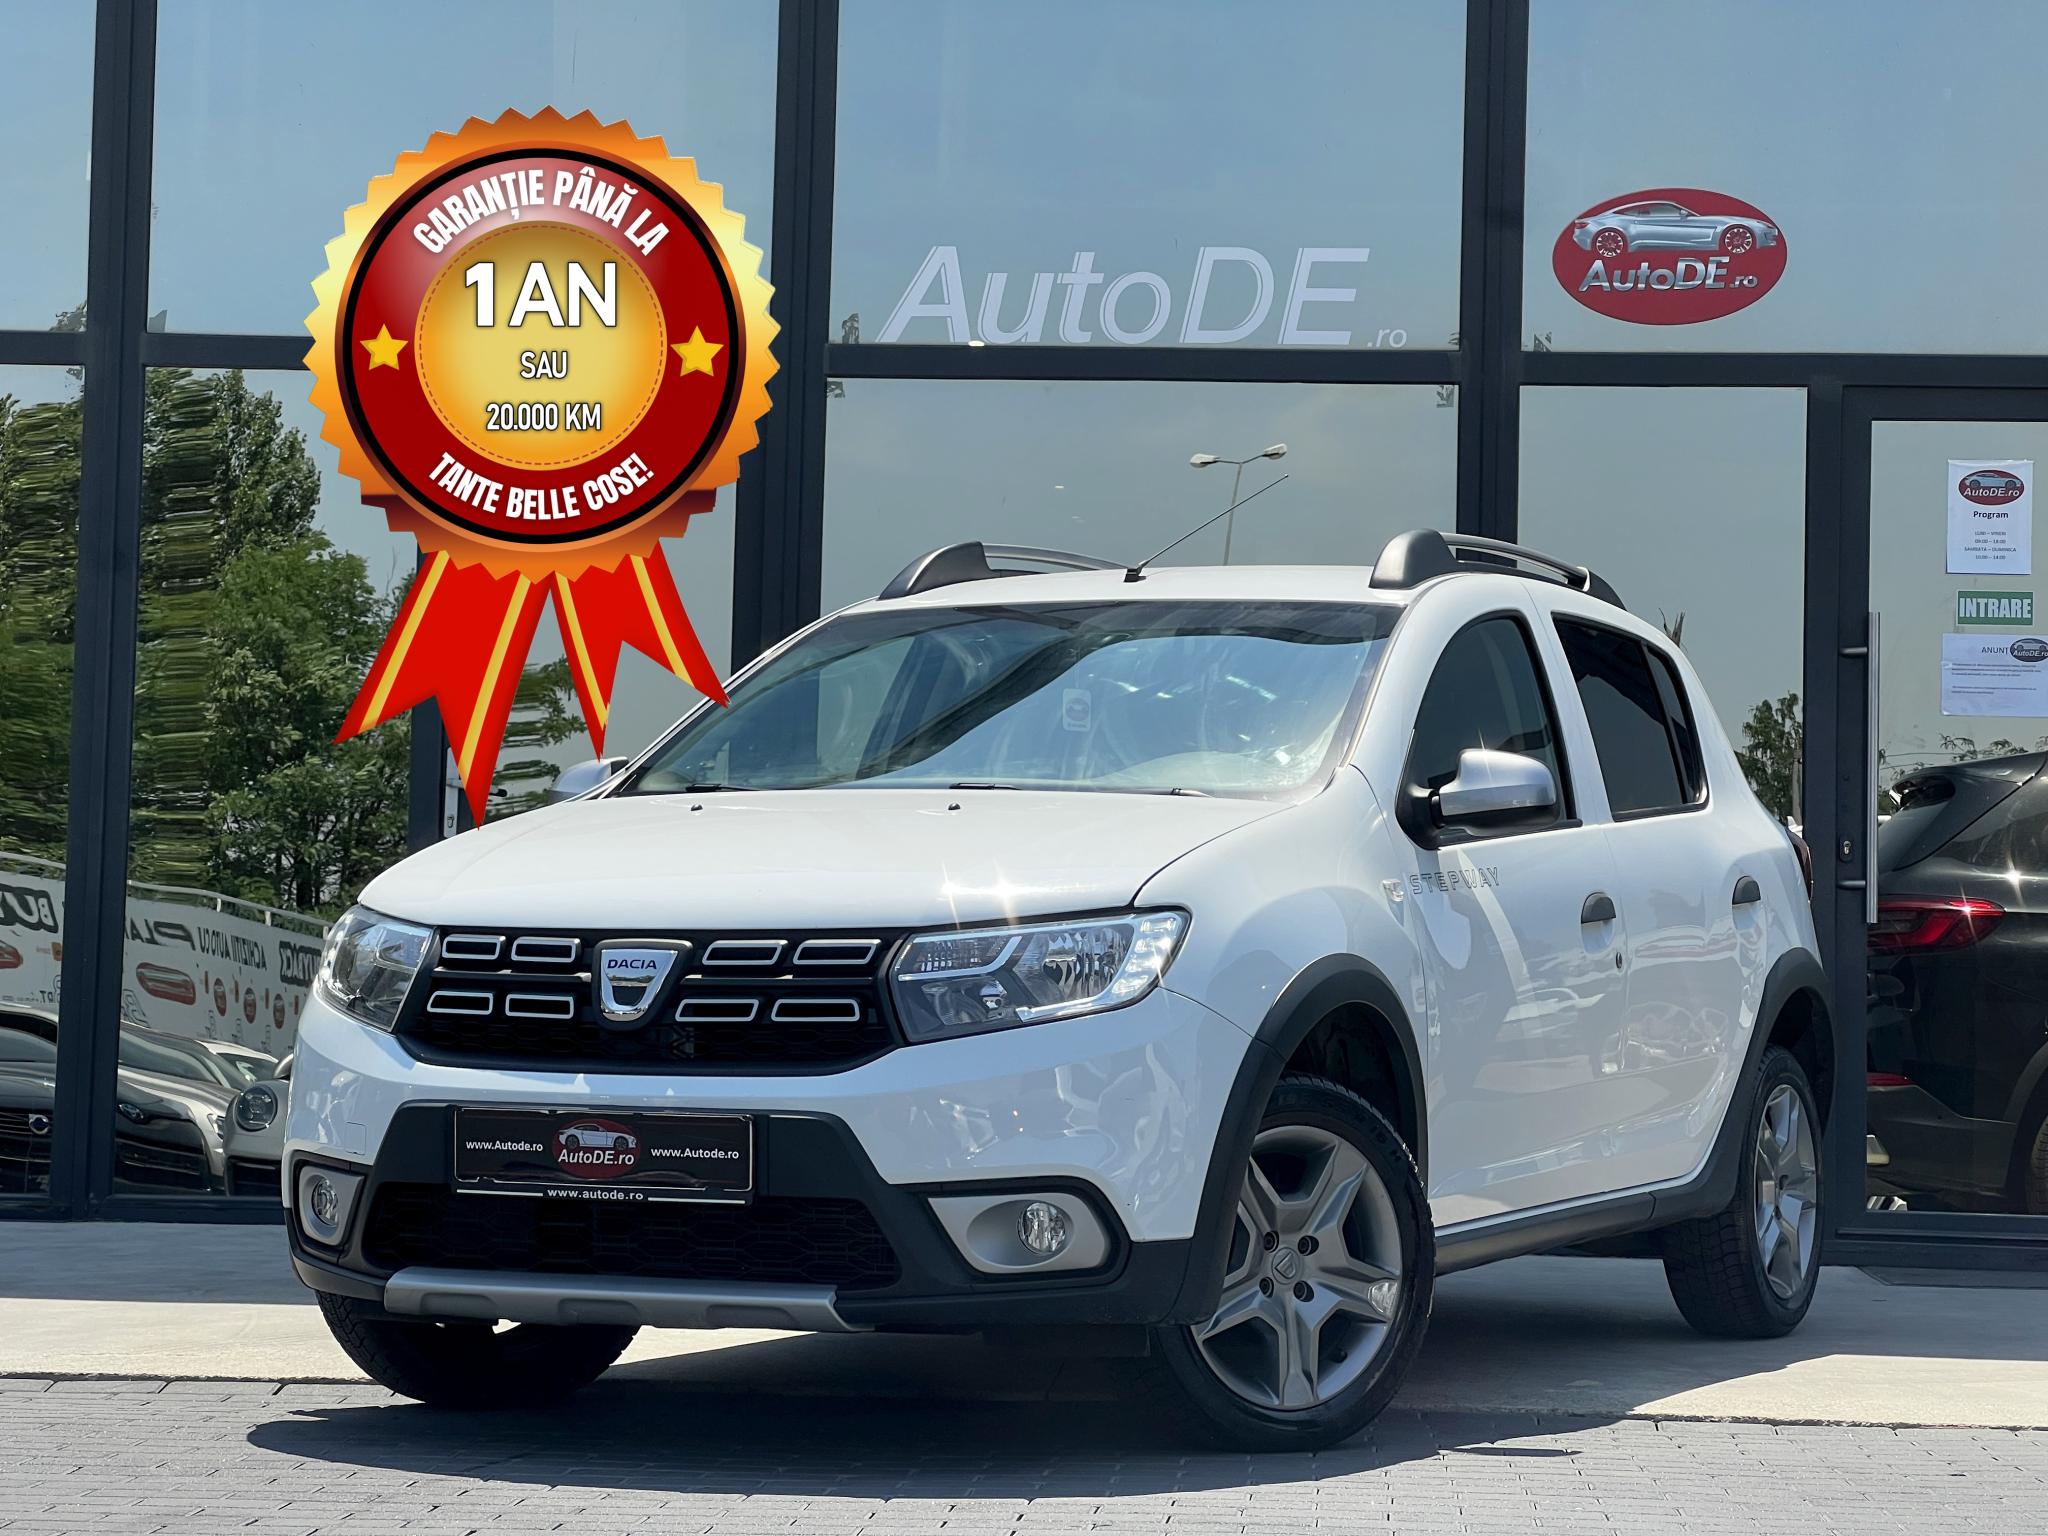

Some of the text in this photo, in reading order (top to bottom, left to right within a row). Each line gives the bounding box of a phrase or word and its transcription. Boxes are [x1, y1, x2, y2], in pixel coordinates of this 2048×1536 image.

[1963, 487, 2020, 497] AutoDE.ro
[1973, 511, 2009, 520] Program
[1959, 597, 2032, 619] INTRARE
[1410, 867, 1500, 895] STEPWAY
[607, 959, 657, 969] DACIA
[466, 1139, 543, 1152] www.Autode.ro
[558, 1149, 635, 1166] AutoDE.ro
[651, 1148, 739, 1160] www.Autode.ro
[547, 1188, 644, 1201] www.autode.ro
